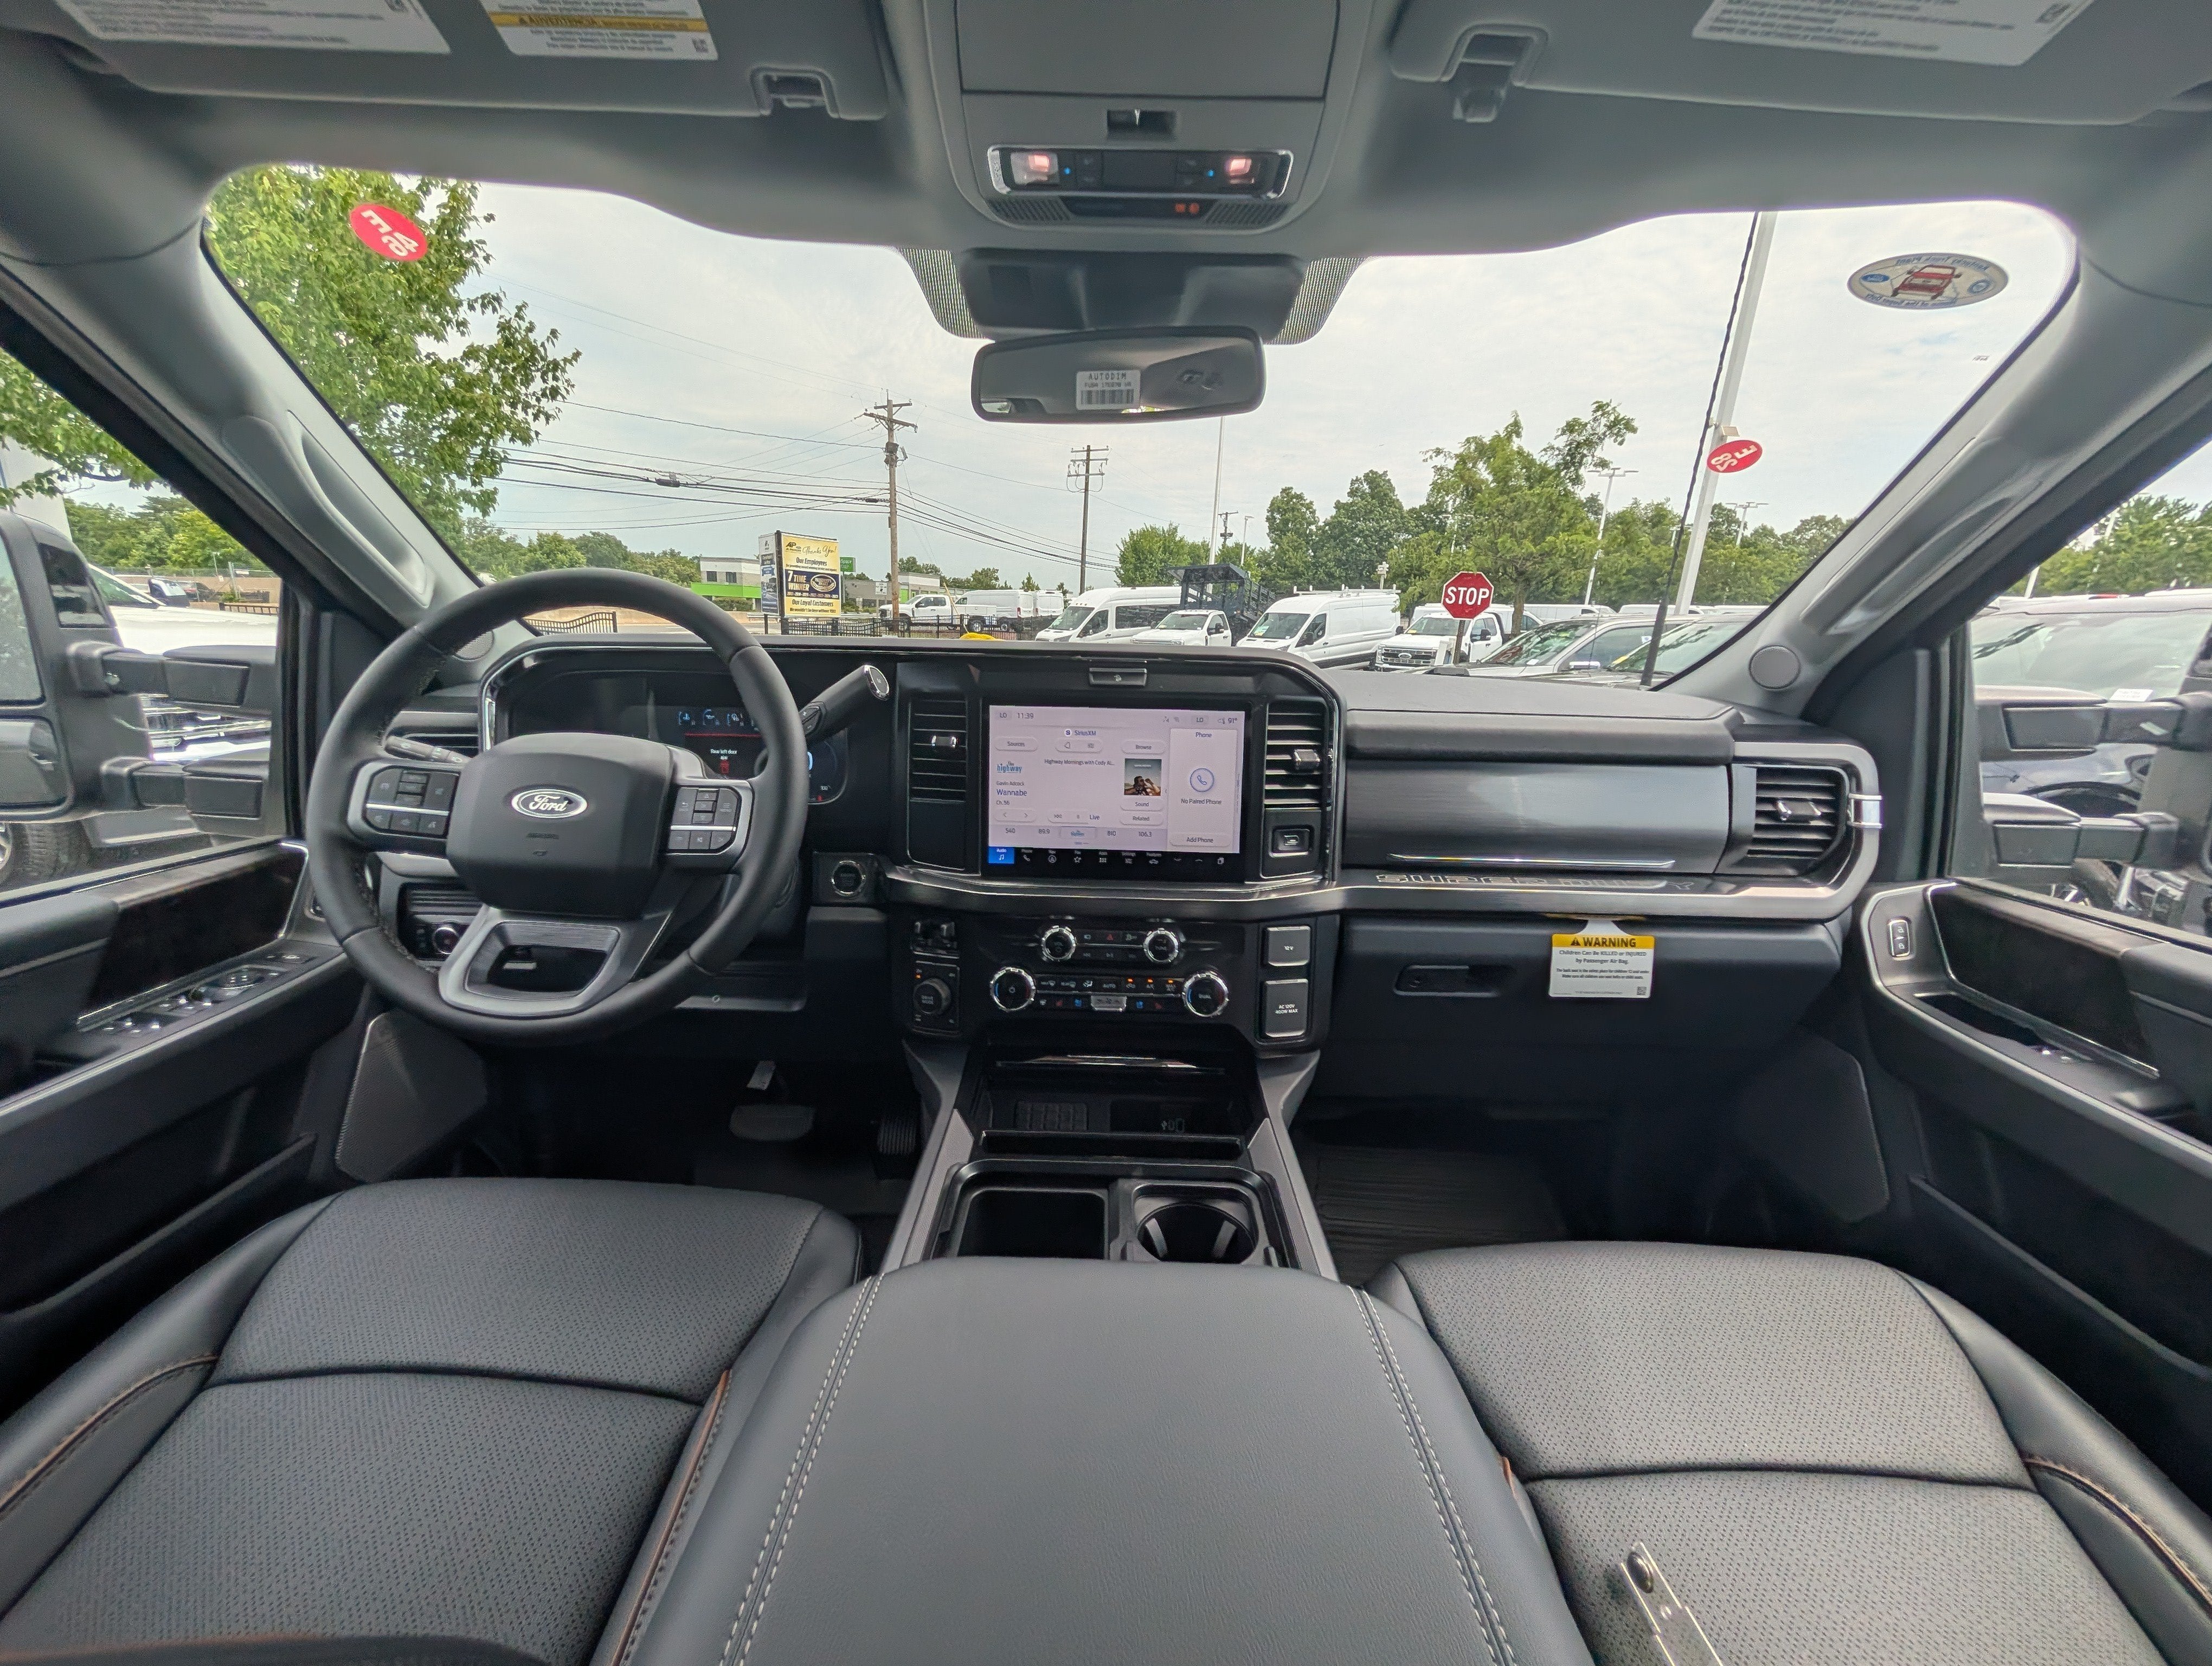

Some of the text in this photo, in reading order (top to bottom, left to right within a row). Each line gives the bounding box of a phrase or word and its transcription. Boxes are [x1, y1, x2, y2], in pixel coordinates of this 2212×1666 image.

[1089, 372, 1127, 380] AUTODIM
[805, 558, 827, 566] Employees
[788, 571, 793, 581] 7
[788, 582, 809, 591] WINNER
[1445, 586, 1489, 606] STOP
[997, 764, 1023, 773] highway
[529, 794, 568, 811] Ford
[1376, 874, 1546, 886] SUPER
[1583, 937, 1636, 947] WARNING
